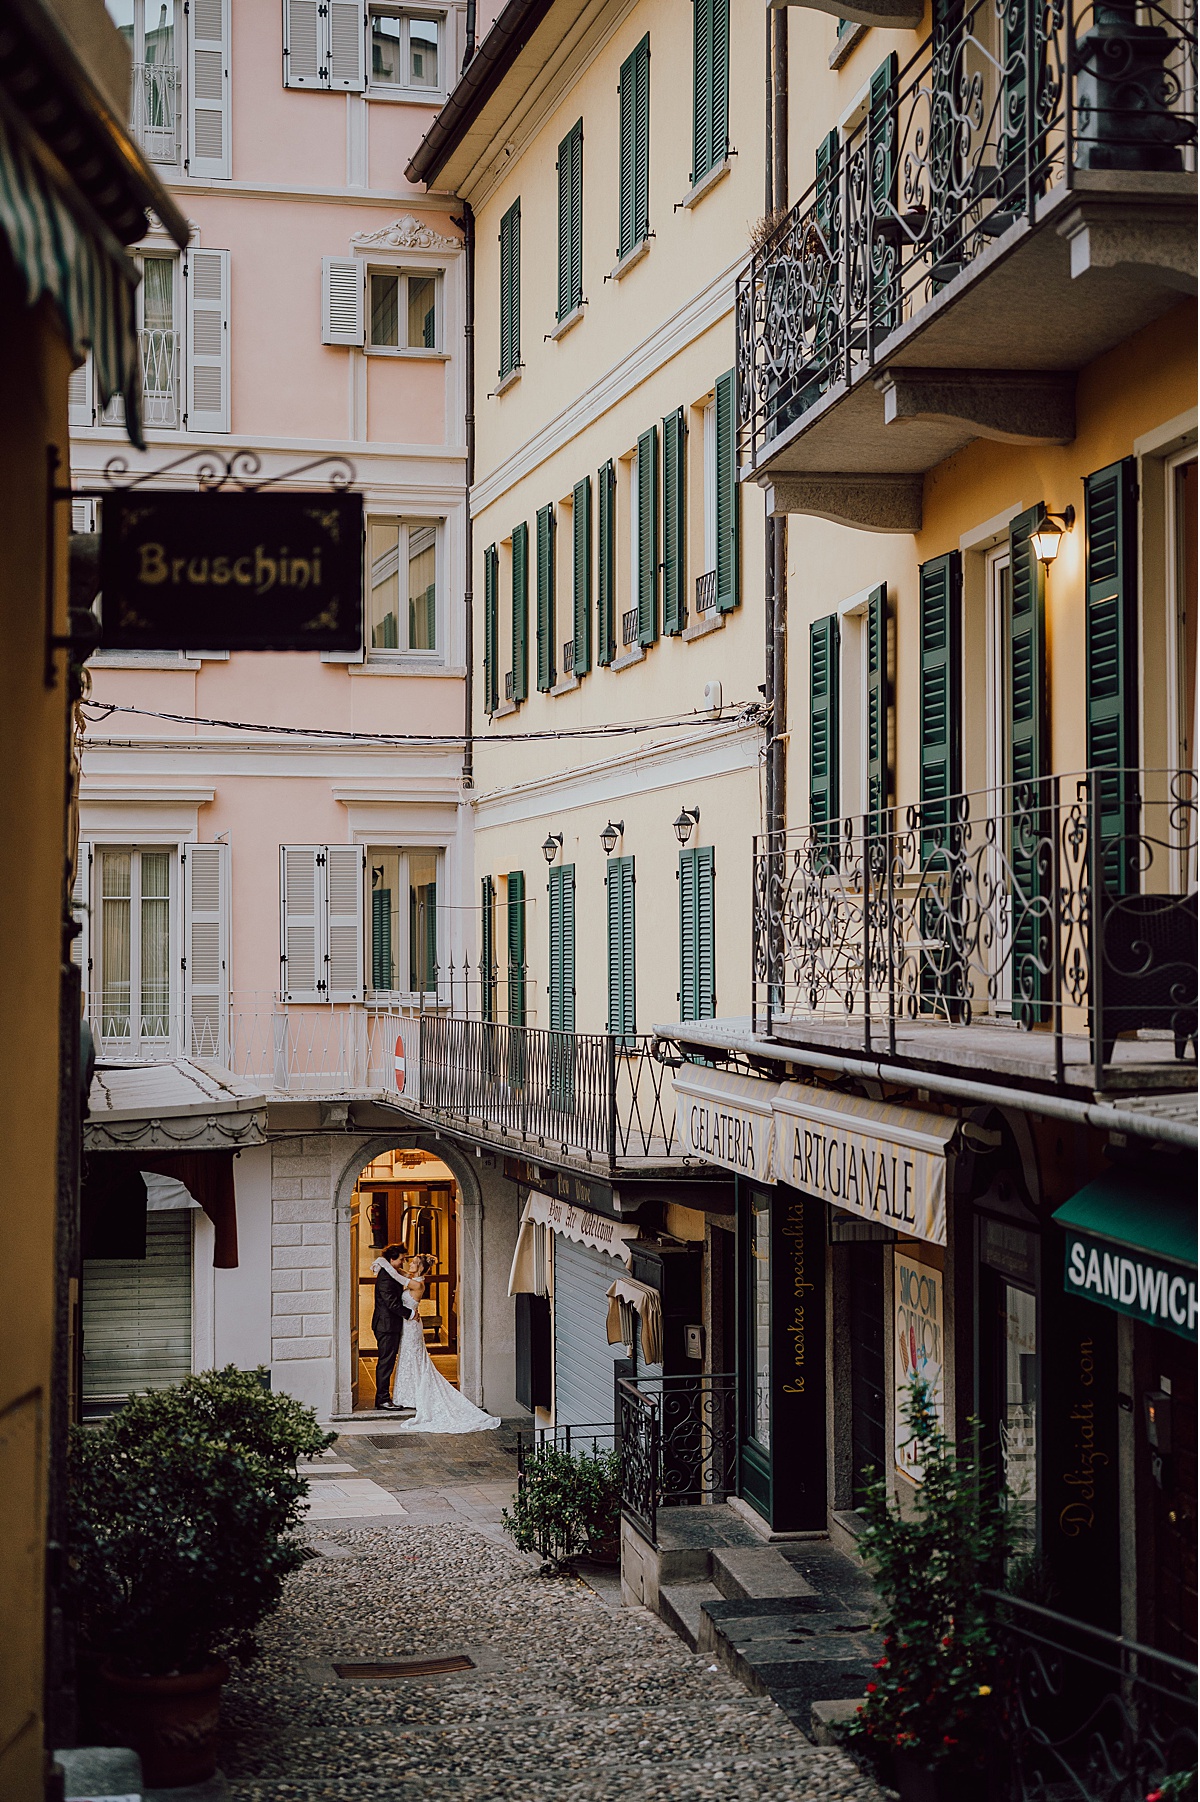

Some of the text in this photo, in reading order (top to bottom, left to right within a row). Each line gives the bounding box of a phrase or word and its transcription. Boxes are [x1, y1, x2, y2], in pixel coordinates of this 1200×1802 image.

[137, 542, 323, 595] Bruschini
[690, 1105, 915, 1224] GELATERIA ARTIGIANALE
[781, 1201, 815, 1394] le nostre specialità
[1058, 1336, 1110, 1537] Deliziati con
